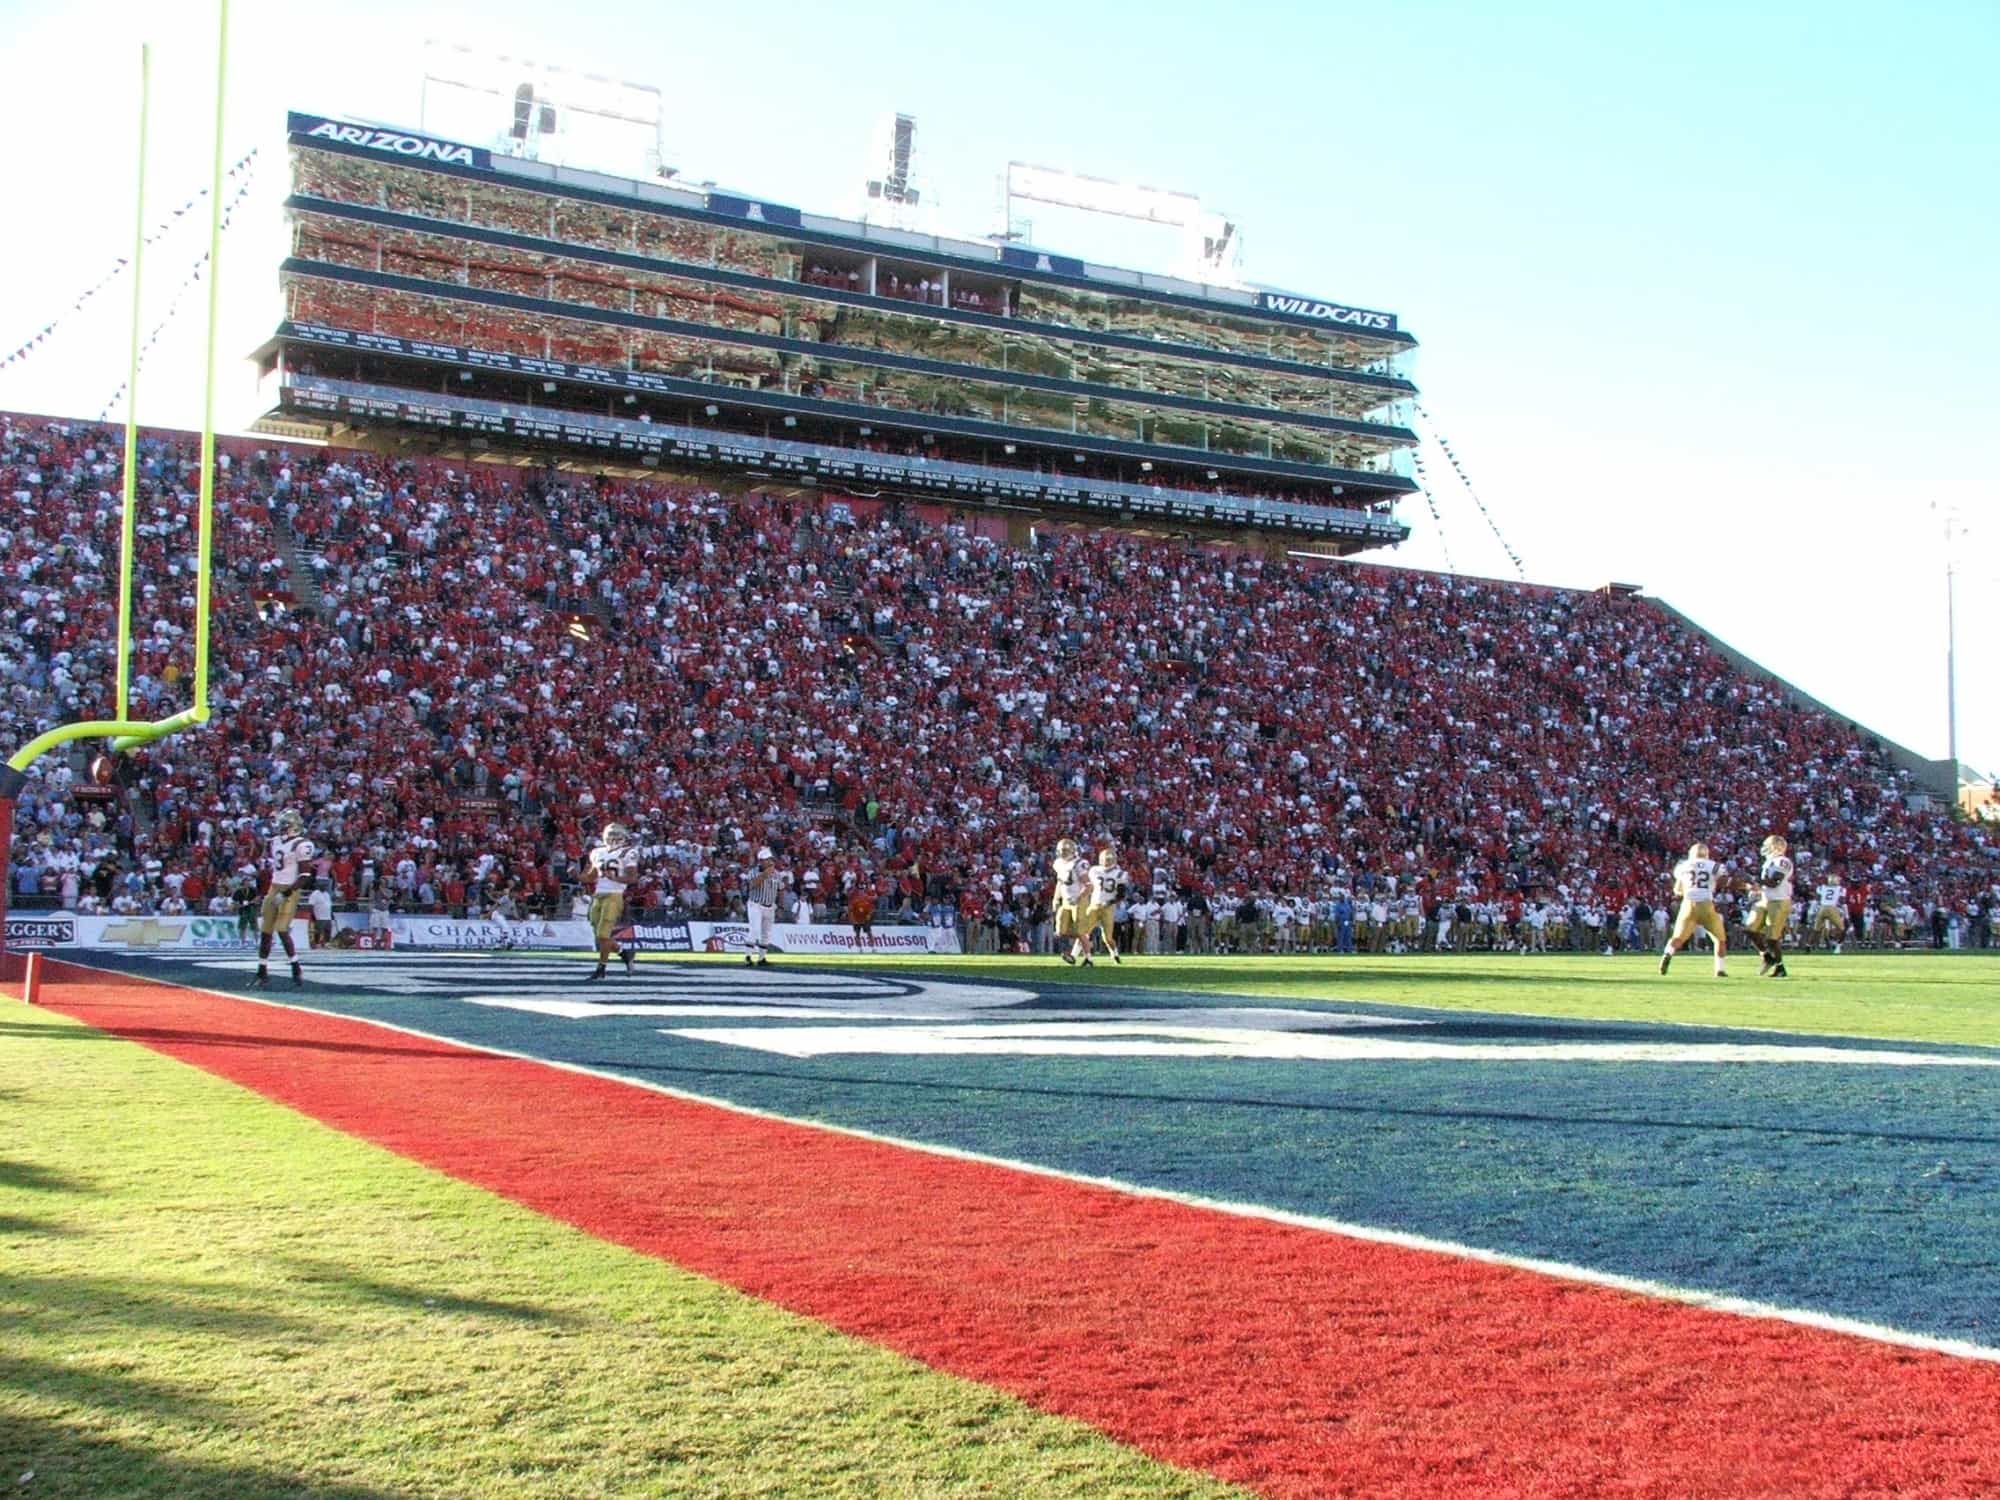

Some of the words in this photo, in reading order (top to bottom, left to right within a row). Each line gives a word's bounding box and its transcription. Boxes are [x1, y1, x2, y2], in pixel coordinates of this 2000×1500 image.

[309, 122, 474, 166] ARIZONA
[1267, 295, 1391, 329] WILDCATS
[455, 936, 531, 946] FUNDNG
[632, 924, 689, 940] Budget
